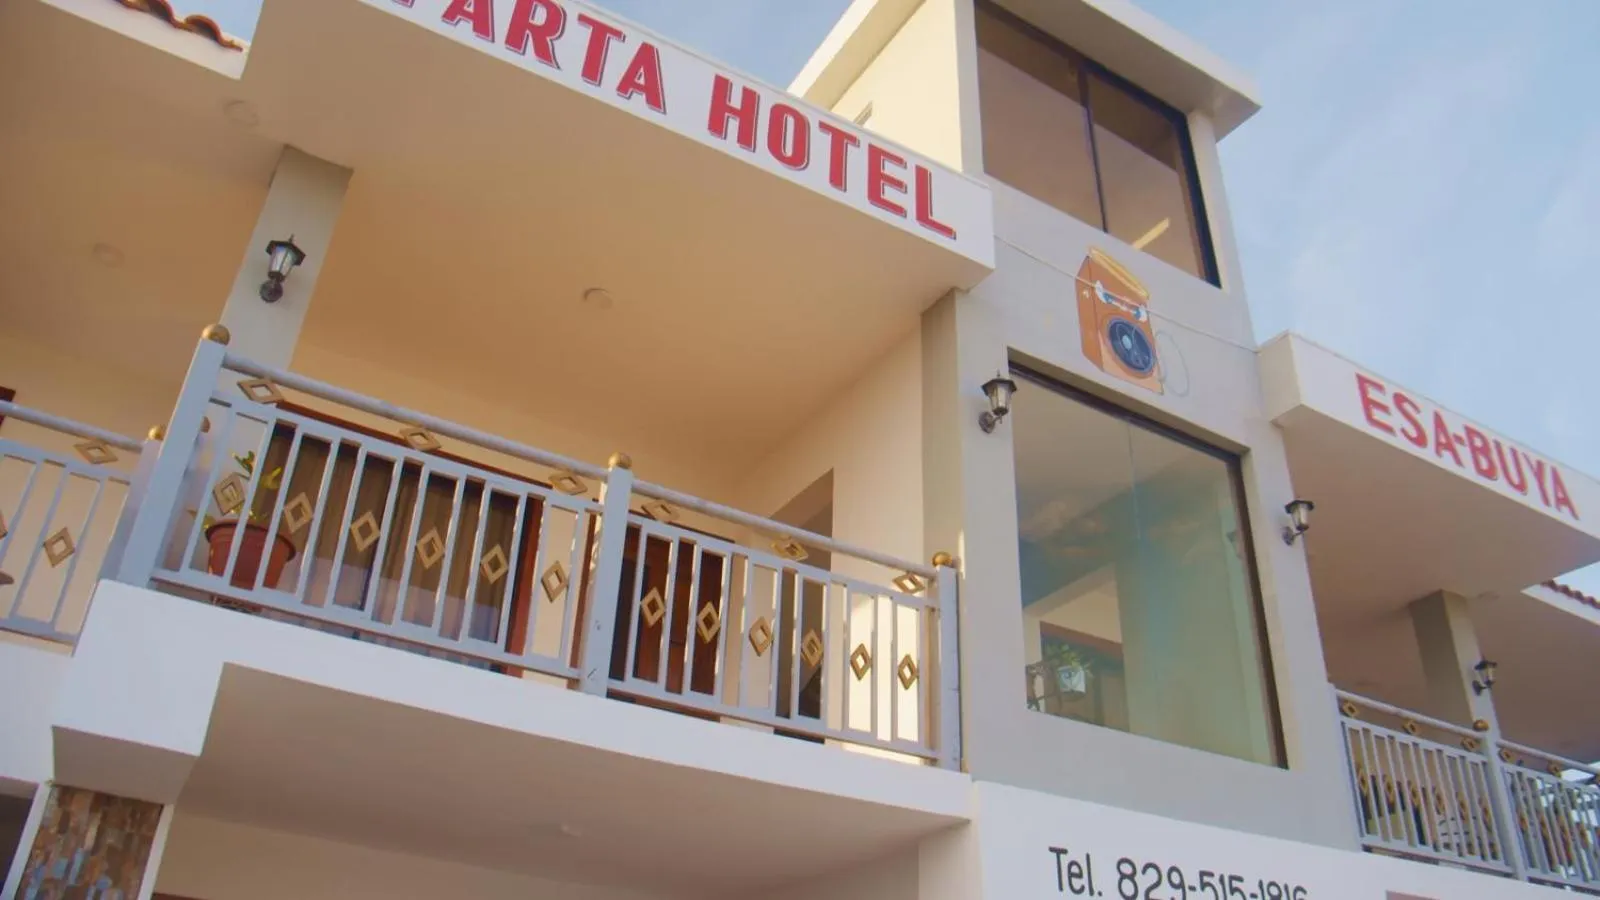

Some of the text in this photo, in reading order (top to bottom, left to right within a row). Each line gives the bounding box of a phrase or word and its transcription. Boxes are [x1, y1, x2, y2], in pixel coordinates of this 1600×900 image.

[391, 0, 957, 240] ARTA HOTEL
[1354, 372, 1581, 521] ESA-BUYA
[1048, 846, 1103, 897] Tel.
